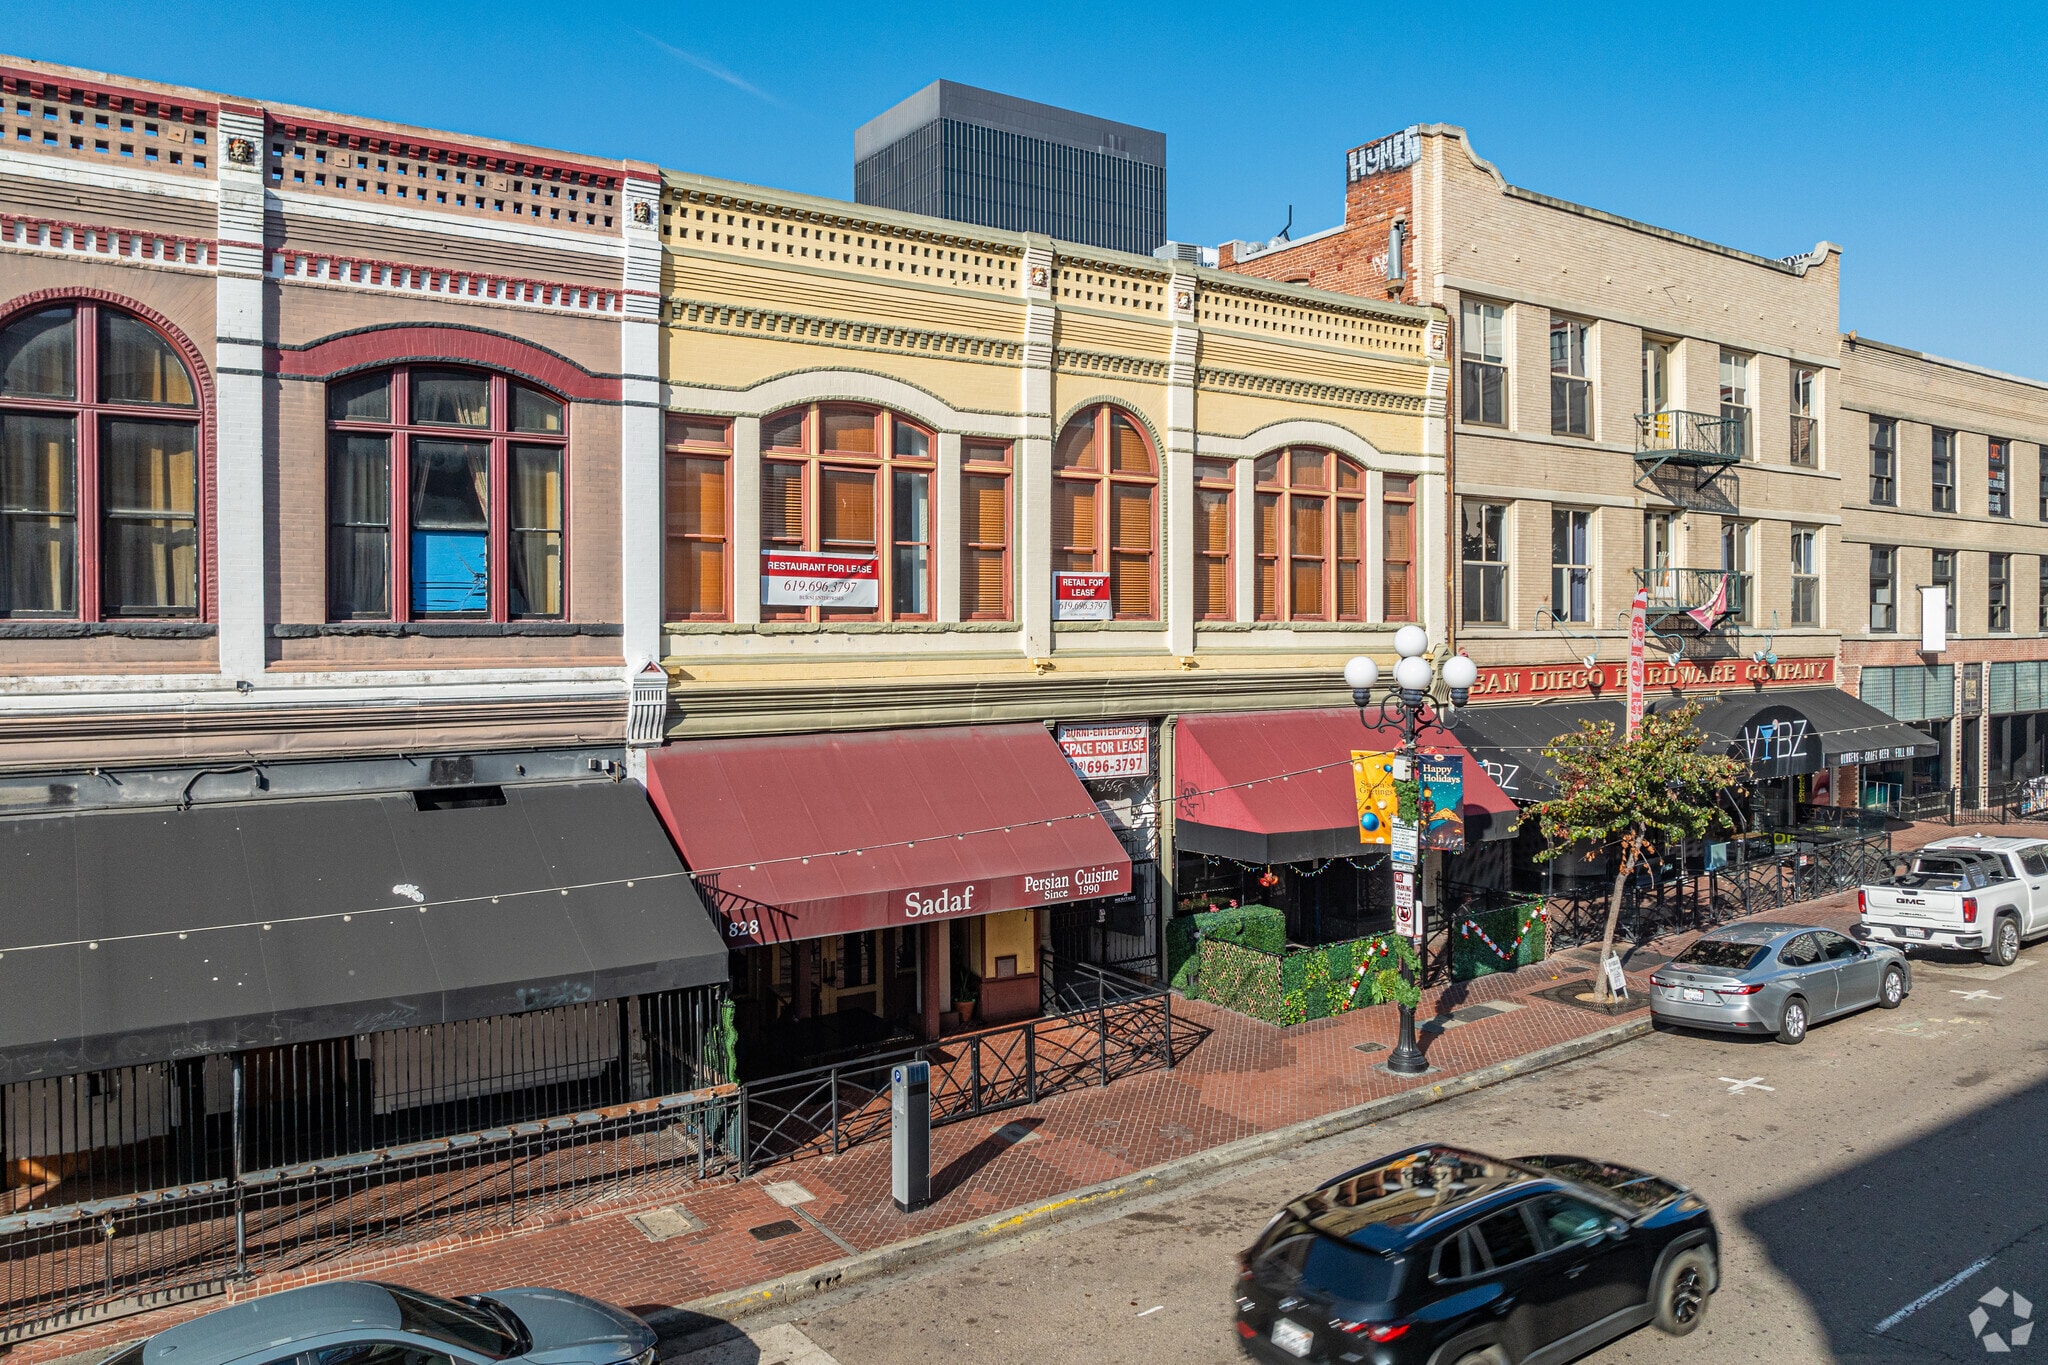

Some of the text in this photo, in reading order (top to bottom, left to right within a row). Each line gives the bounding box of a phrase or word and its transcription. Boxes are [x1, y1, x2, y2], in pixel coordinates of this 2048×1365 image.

[768, 561, 872, 574] RESTAURANT FOR LEASE
[784, 580, 857, 593] 619.696.3797
[1062, 578, 1104, 587] RETAIL FOR
[1071, 588, 1095, 597] LEASE
[1059, 601, 1108, 610] 619.696.3797
[1470, 662, 1828, 694] SAN DIEGO HRDWARE COMPANY
[1065, 725, 1142, 738] BURNI-ENTERPRISES
[1063, 740, 1144, 755] SPACE FOR LEASE
[1087, 758, 1143, 773] 696-3797
[1422, 763, 1453, 774] Happy
[1423, 774, 1461, 785] Holidays
[1024, 866, 1119, 894] Persian Cuisine
[1044, 883, 1100, 900] Since 1990
[905, 885, 975, 918] Sadaf
[1896, 897, 1926, 906] GMC
[728, 919, 759, 937] 828
